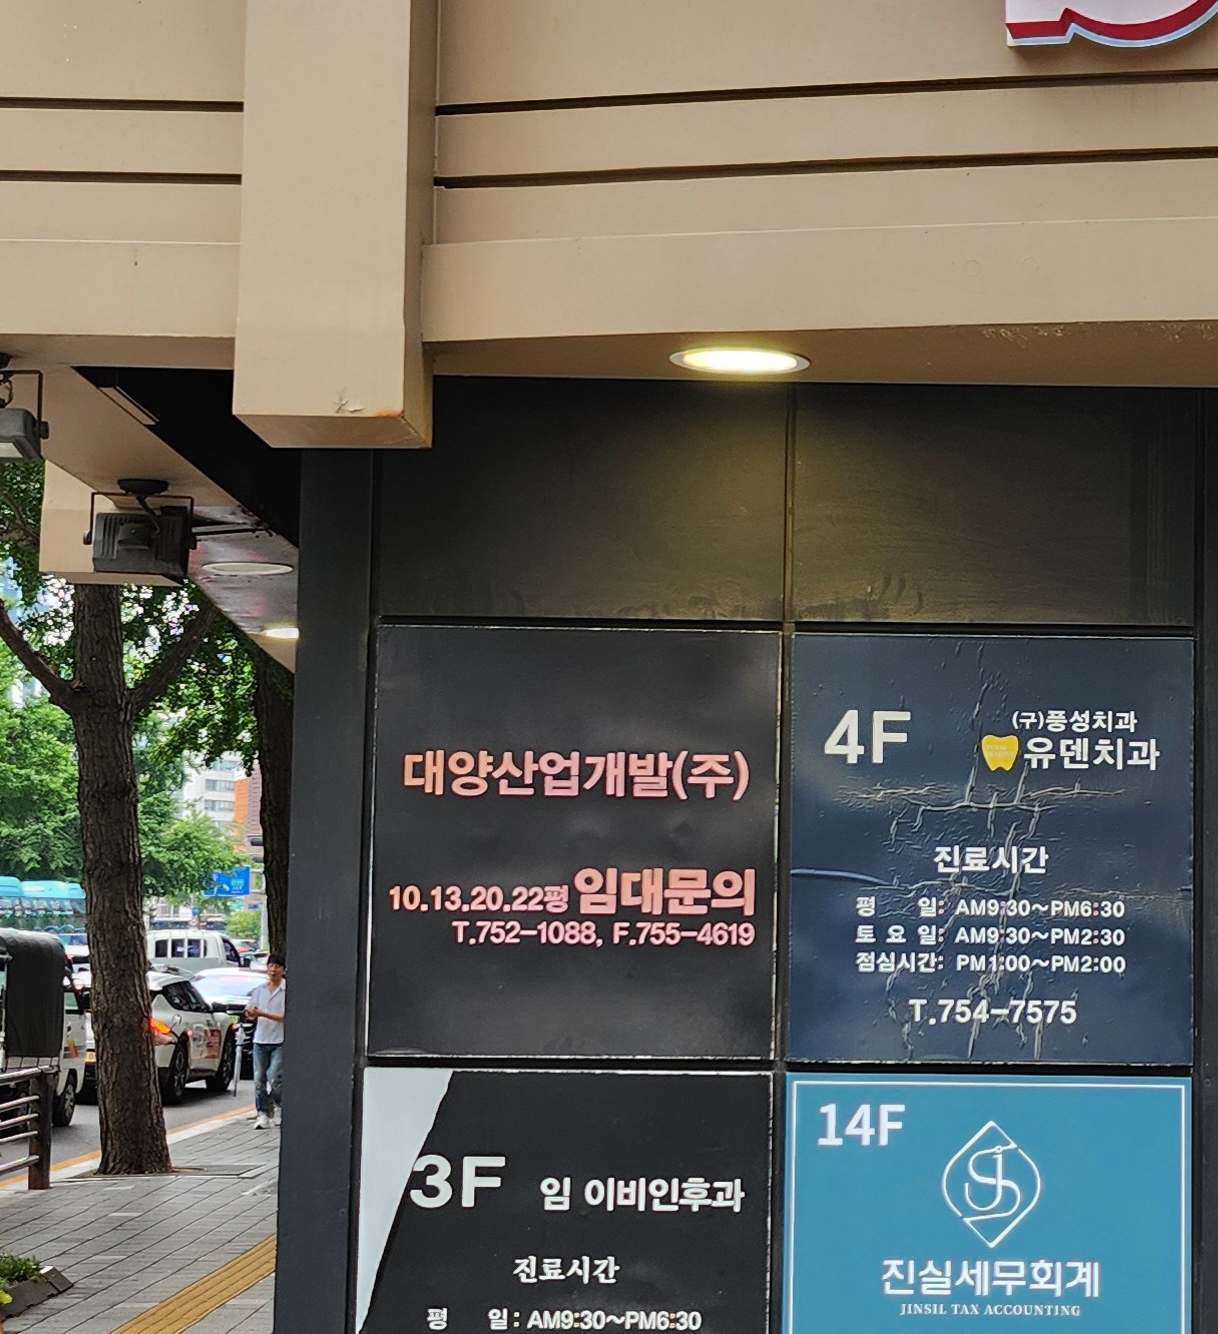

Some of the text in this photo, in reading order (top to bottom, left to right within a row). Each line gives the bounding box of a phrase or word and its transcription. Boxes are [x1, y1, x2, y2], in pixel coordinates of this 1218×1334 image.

[1011, 709, 1138, 733] (구)풍성치과
[824, 709, 912, 764] 4F
[1023, 736, 1161, 771] 유덴치과
[404, 749, 749, 801] 대양산업개발(주)
[933, 847, 1048, 874] 진료시간
[389, 867, 756, 916] 10.13.20.22평 임대문의
[956, 899, 1125, 918] AM9:30~PM6:30
[451, 920, 755, 948] T.752-1088, F.755-4619
[955, 927, 1125, 946] AM9:30~PM2:30
[856, 953, 1126, 974] 점심시간: PM1:00~PM2:00
[909, 999, 1077, 1025] T.754-7575
[817, 1103, 906, 1147] 14F
[410, 1155, 745, 1213] 3F 임 이비인후과
[512, 1255, 621, 1285] 진료시간
[881, 1259, 1099, 1298] 진실세무회계
[526, 1309, 702, 1331] AM9:30~PM6:30
[899, 1303, 948, 1316] JINSIL
[950, 1303, 980, 1315] TAX
